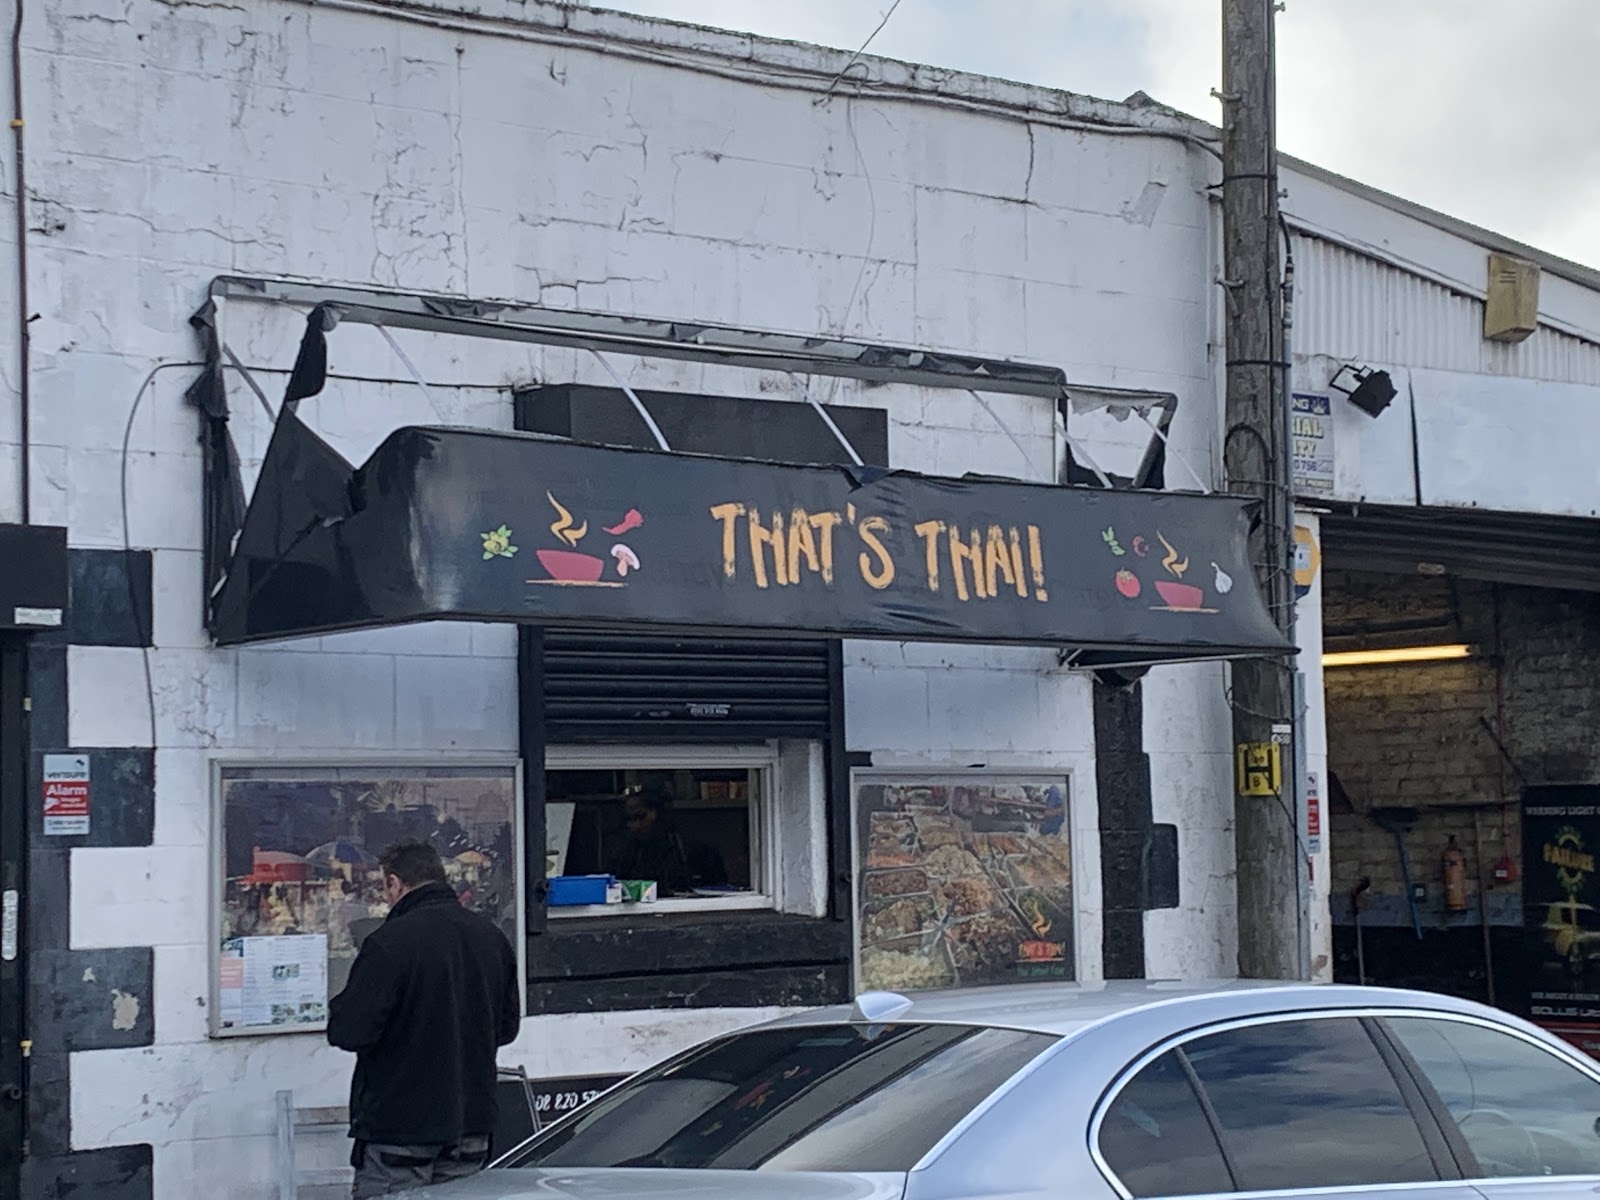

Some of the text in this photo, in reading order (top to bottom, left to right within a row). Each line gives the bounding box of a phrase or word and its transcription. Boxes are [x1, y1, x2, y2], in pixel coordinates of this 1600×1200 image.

[710, 502, 1048, 602] THAT'S THAI!
[46, 784, 87, 796] Alarm
[554, 1091, 579, 1110] 820
